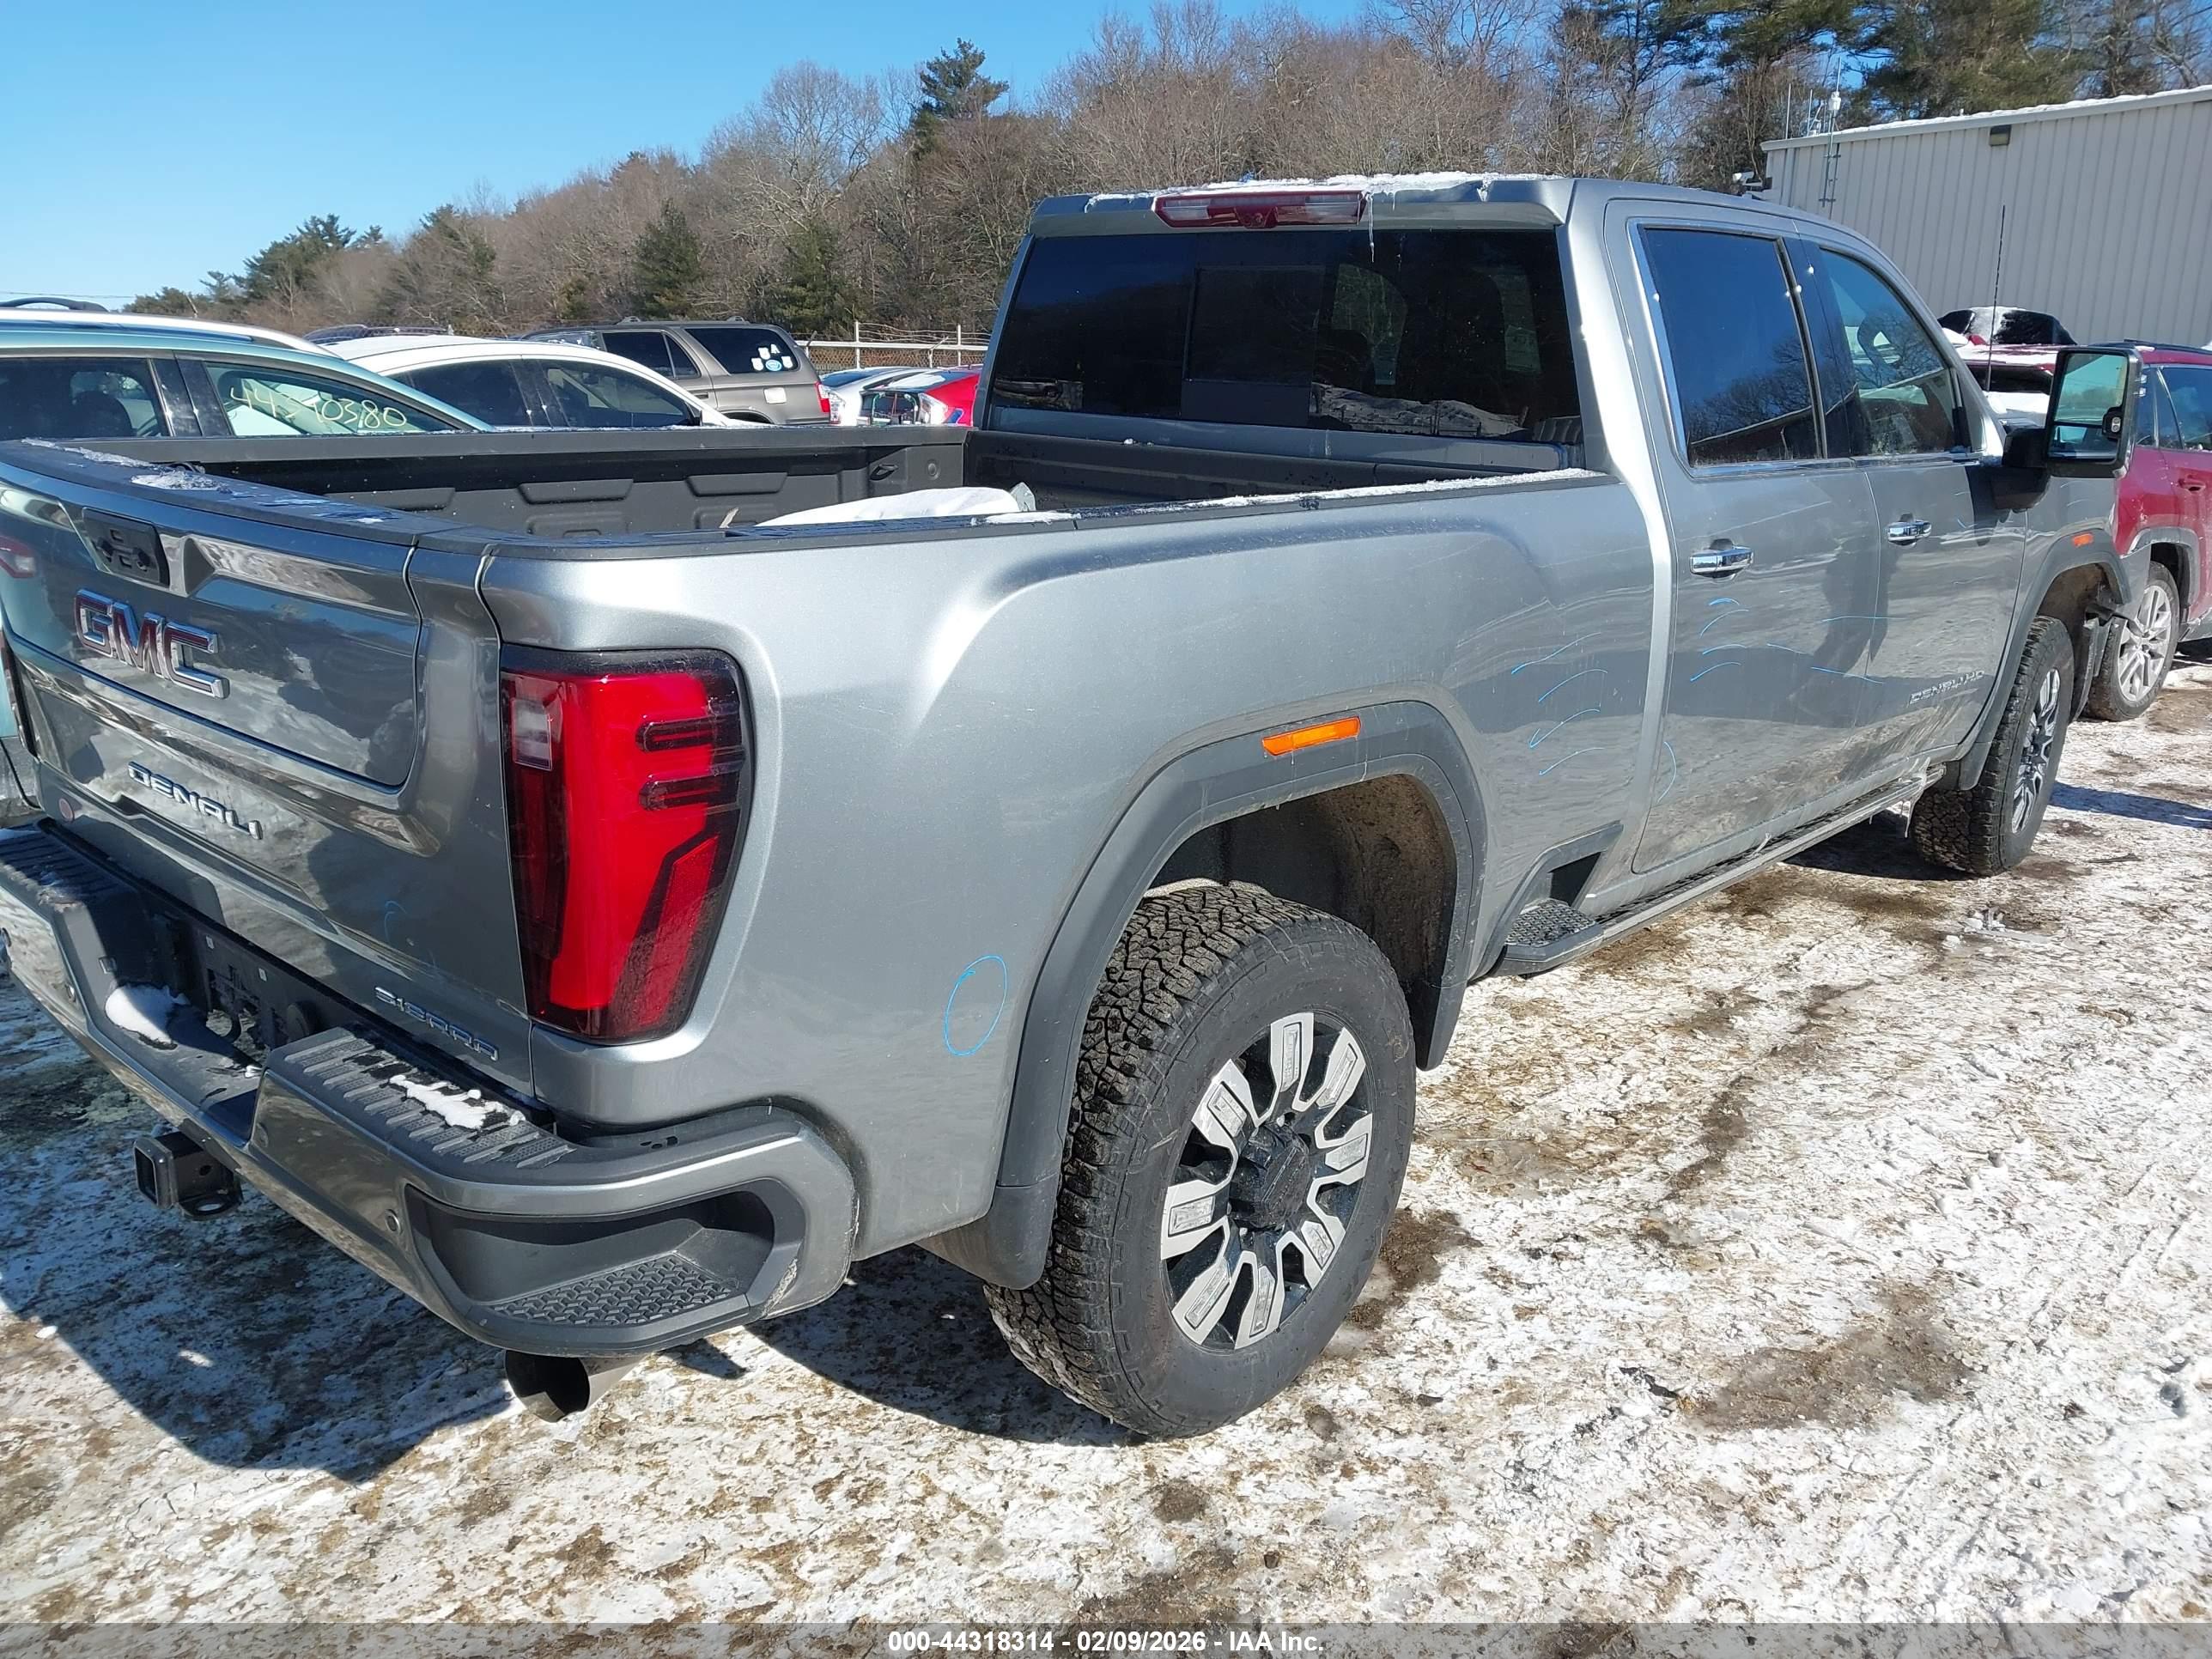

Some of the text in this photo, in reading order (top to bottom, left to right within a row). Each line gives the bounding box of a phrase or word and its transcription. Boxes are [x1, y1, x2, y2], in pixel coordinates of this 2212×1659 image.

[75, 589, 230, 699] GMC
[128, 761, 264, 840] DENALI
[374, 986, 499, 1061] SIERRA
